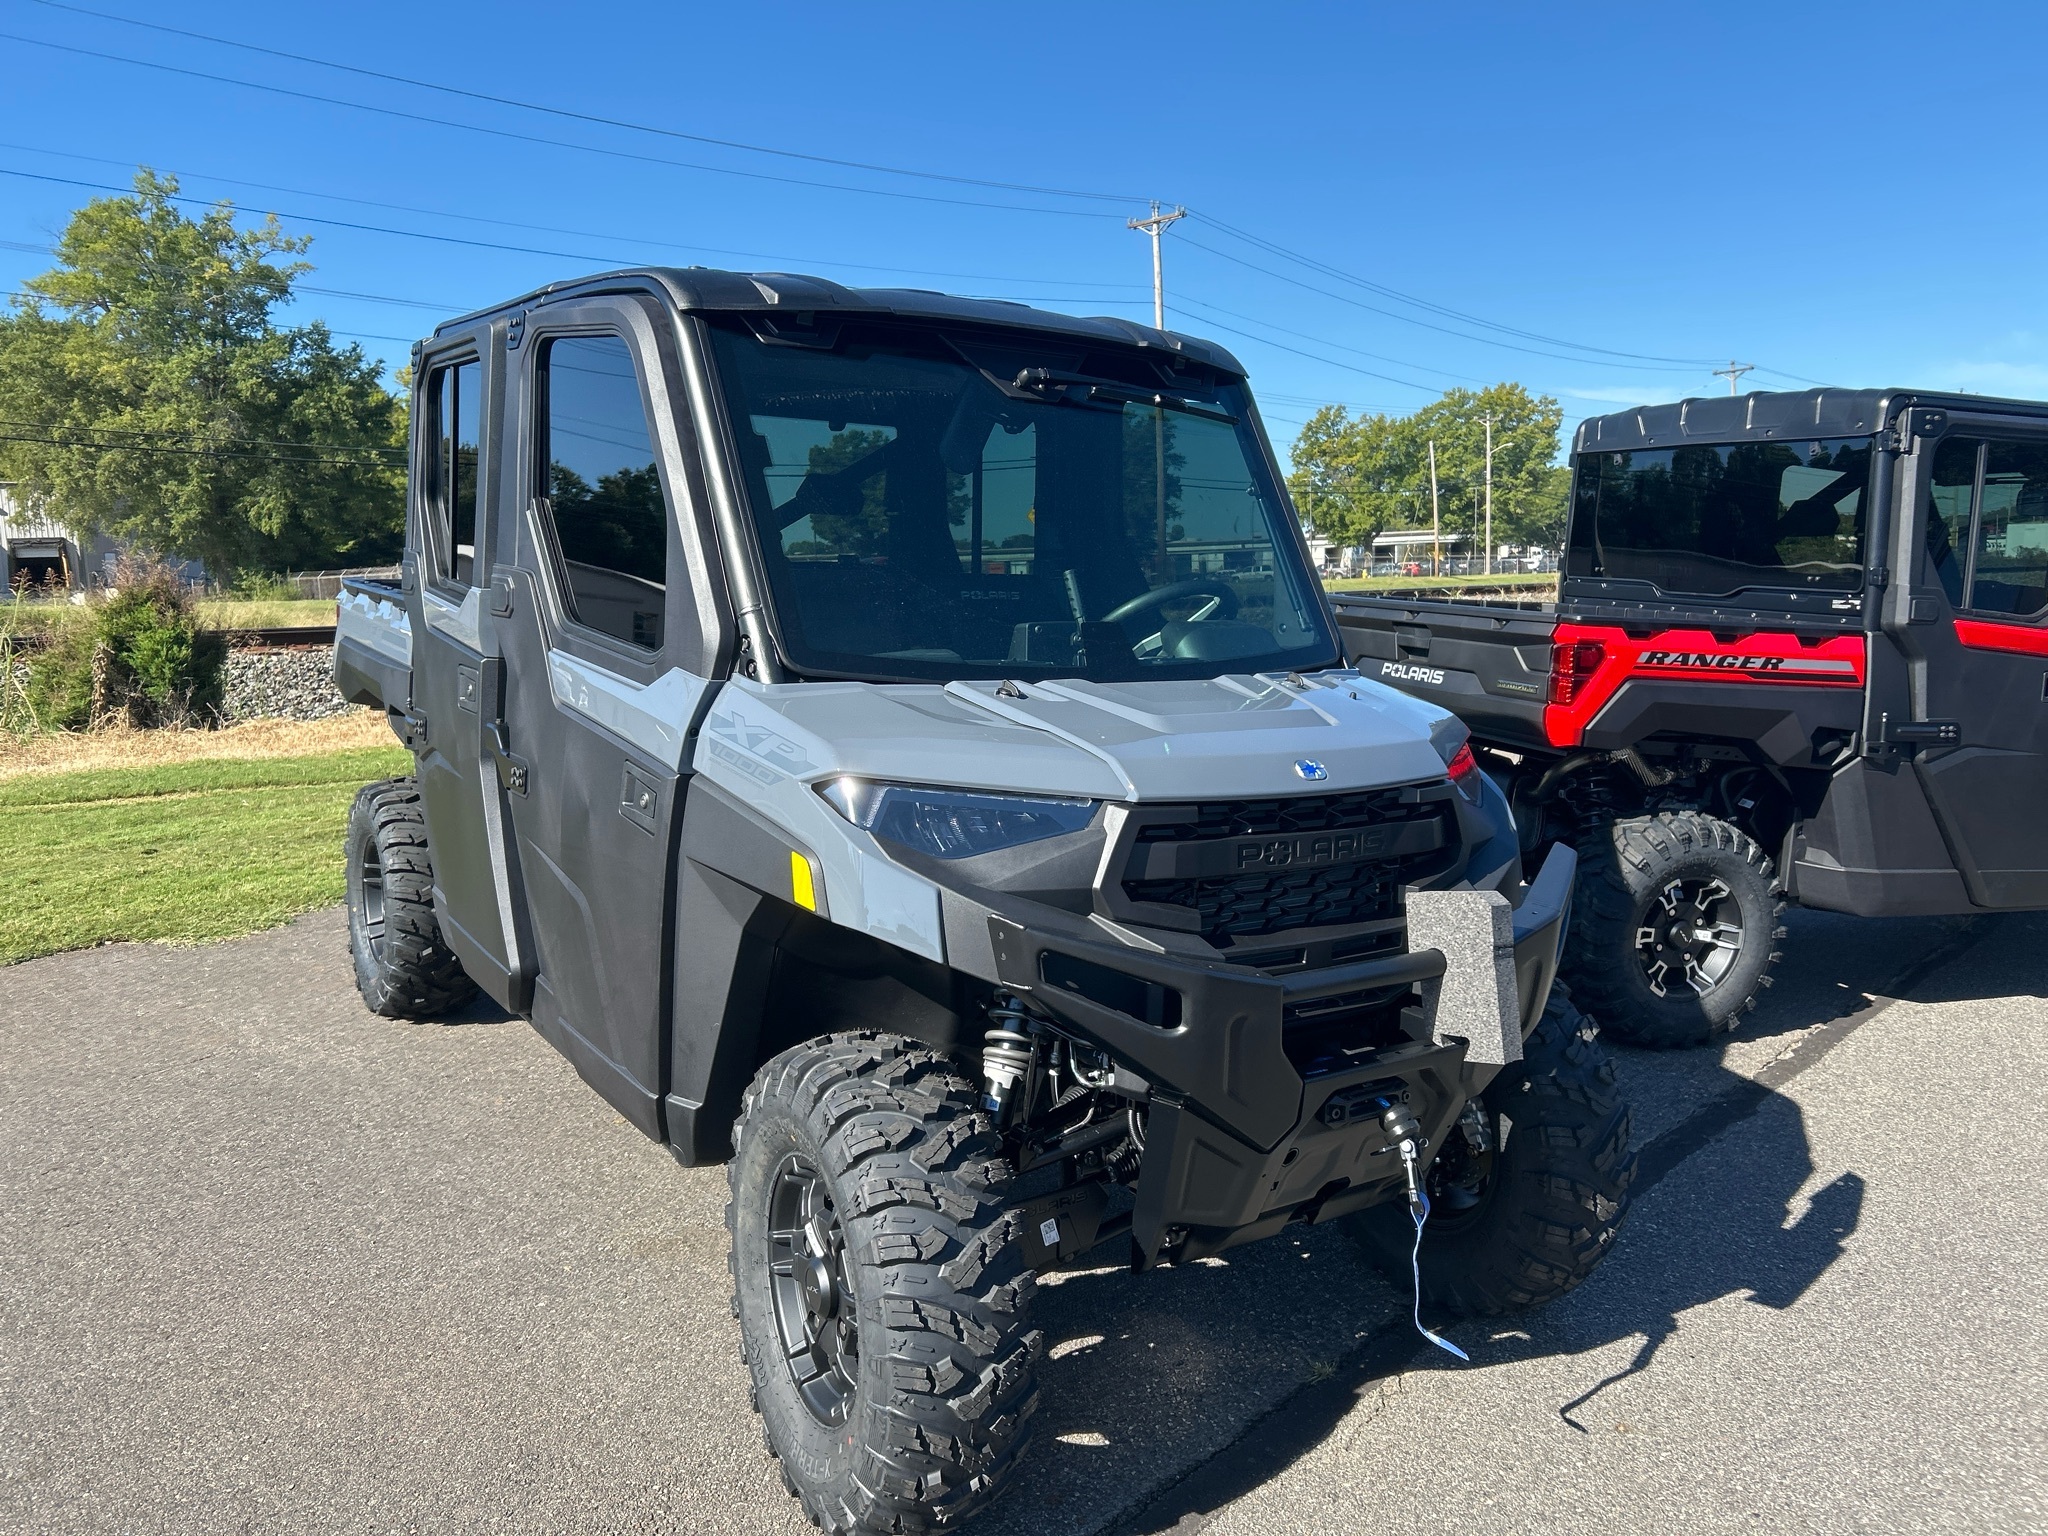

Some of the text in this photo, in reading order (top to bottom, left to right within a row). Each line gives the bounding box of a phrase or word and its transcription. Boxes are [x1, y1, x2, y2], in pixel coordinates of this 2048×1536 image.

[960, 590, 1020, 600] POLARIS
[1381, 662, 1445, 684] POLARIS
[1644, 651, 1784, 670] RANGER
[711, 710, 807, 762] XP
[714, 743, 776, 783] 1000
[1237, 829, 1385, 870] POLARIS
[1025, 1191, 1088, 1217] OLARIS
